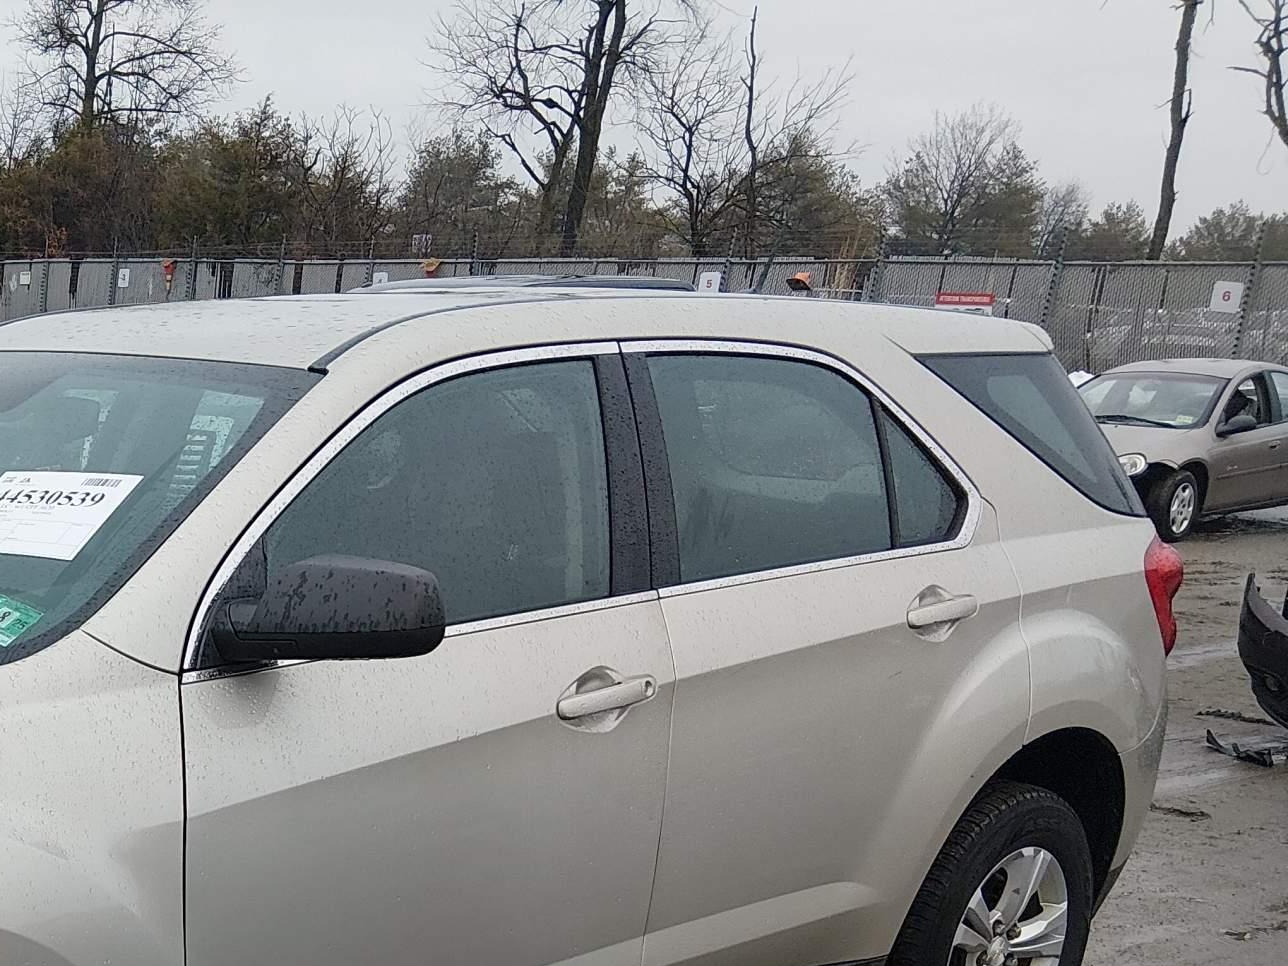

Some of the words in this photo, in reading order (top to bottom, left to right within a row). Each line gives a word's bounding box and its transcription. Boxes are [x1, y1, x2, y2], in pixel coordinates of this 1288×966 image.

[706, 279, 713, 288] 5
[1222, 290, 1232, 302] 6
[12, 618, 28, 631] 25
